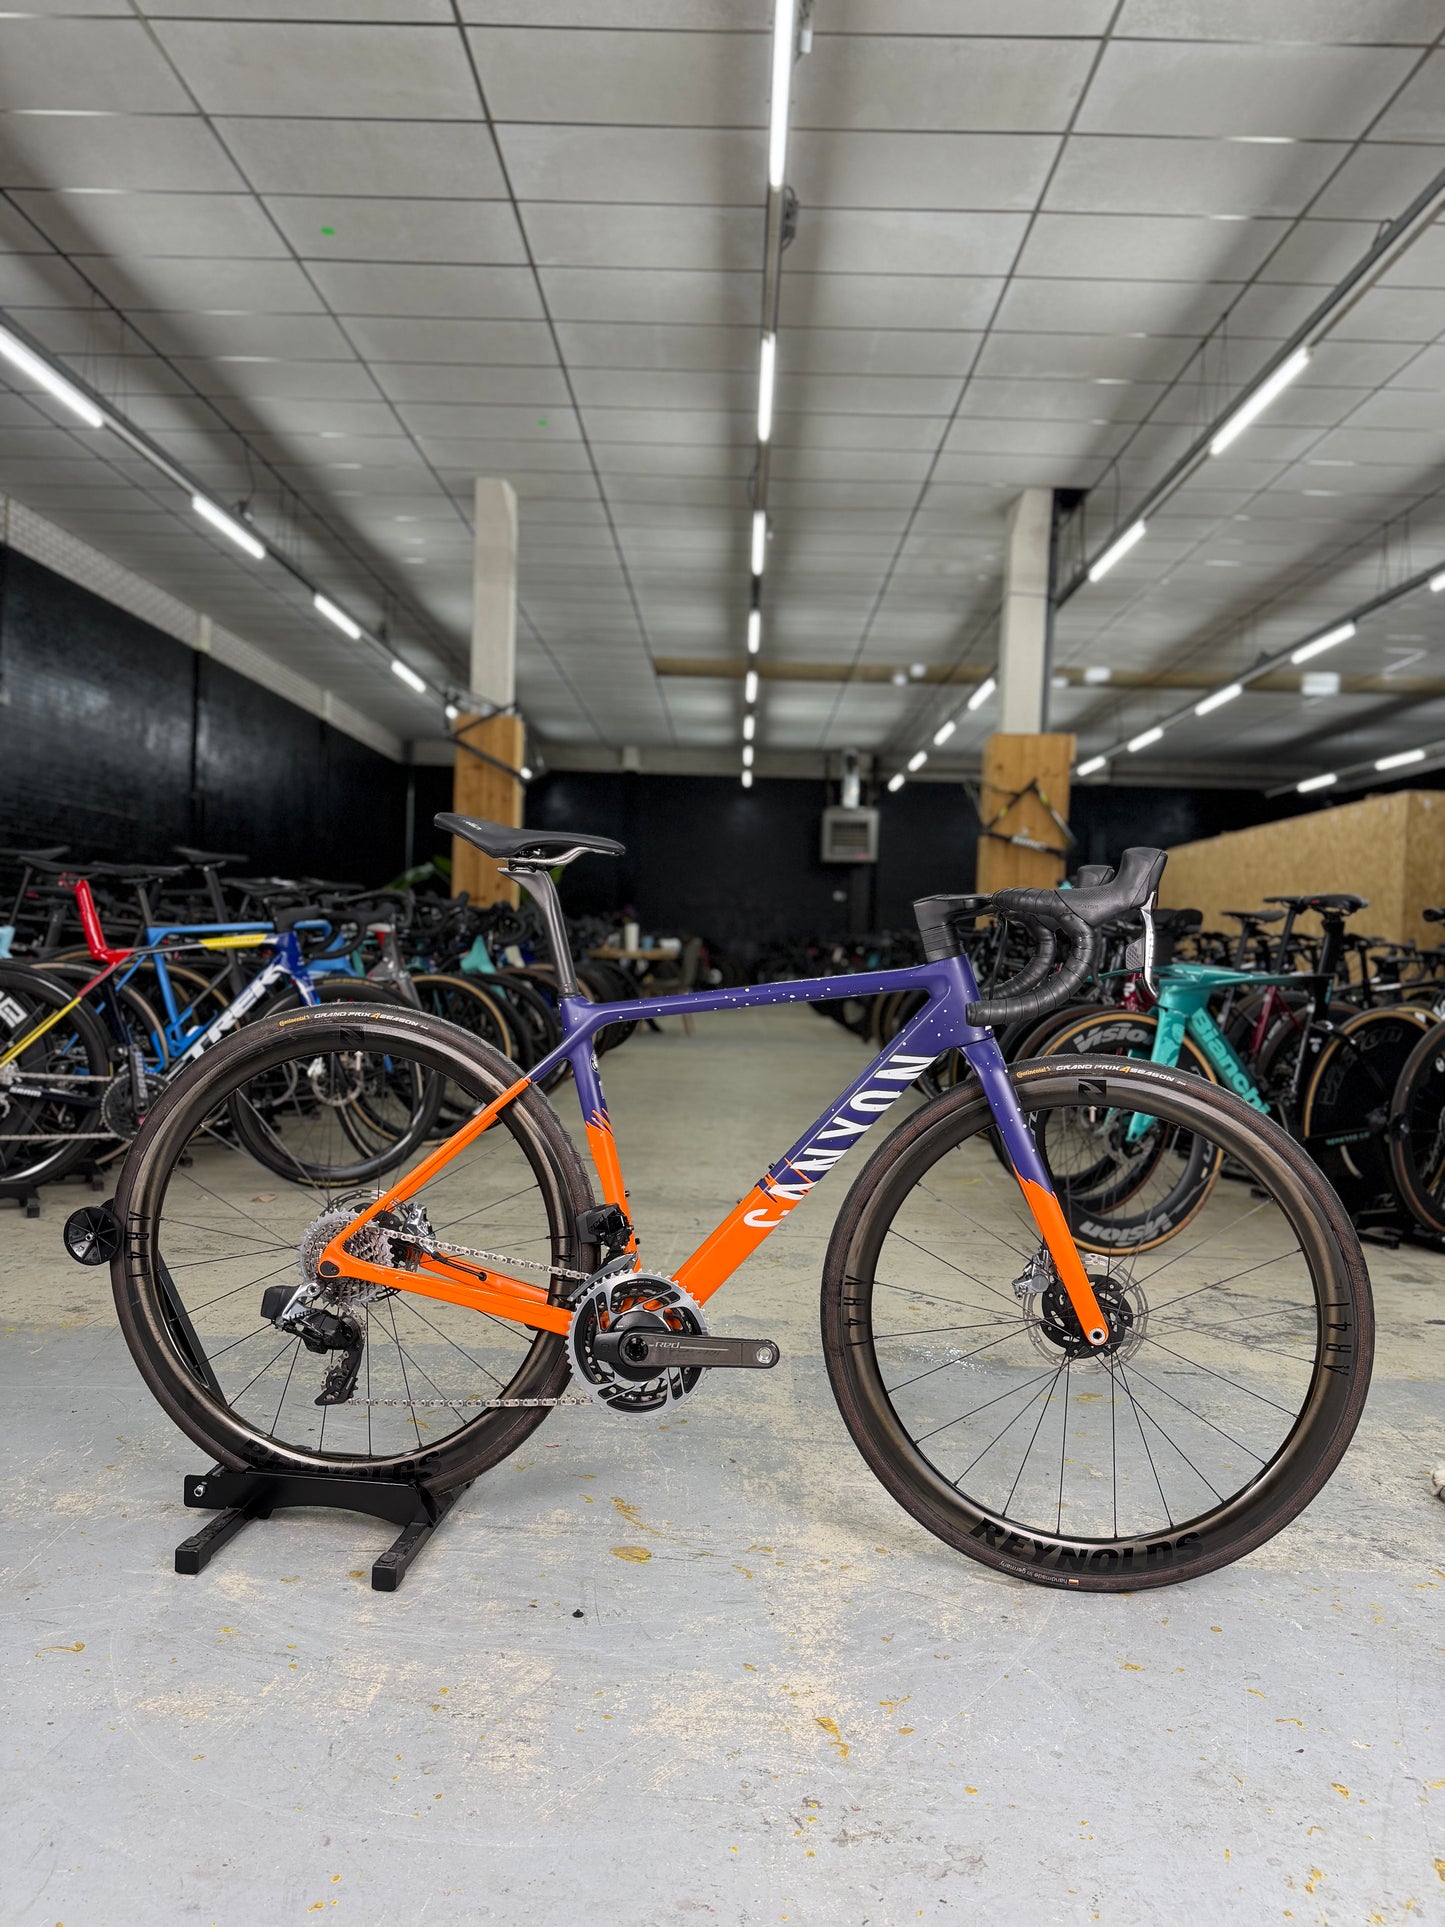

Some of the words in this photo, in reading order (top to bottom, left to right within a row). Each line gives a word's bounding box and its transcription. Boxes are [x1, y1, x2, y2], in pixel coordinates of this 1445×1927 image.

[182, 964, 281, 1060] TREK
[279, 1014, 308, 1027] Continental
[1073, 1022, 1152, 1053] Visio
[1016, 1066, 1047, 1079] Continental
[744, 1054, 938, 1228] CANYON
[1079, 1212, 1173, 1247] Vision
[969, 1517, 1204, 1571] REYNOLDS
[999, 1560, 1026, 1574] germany
[1033, 1573, 1068, 1584] handmade
